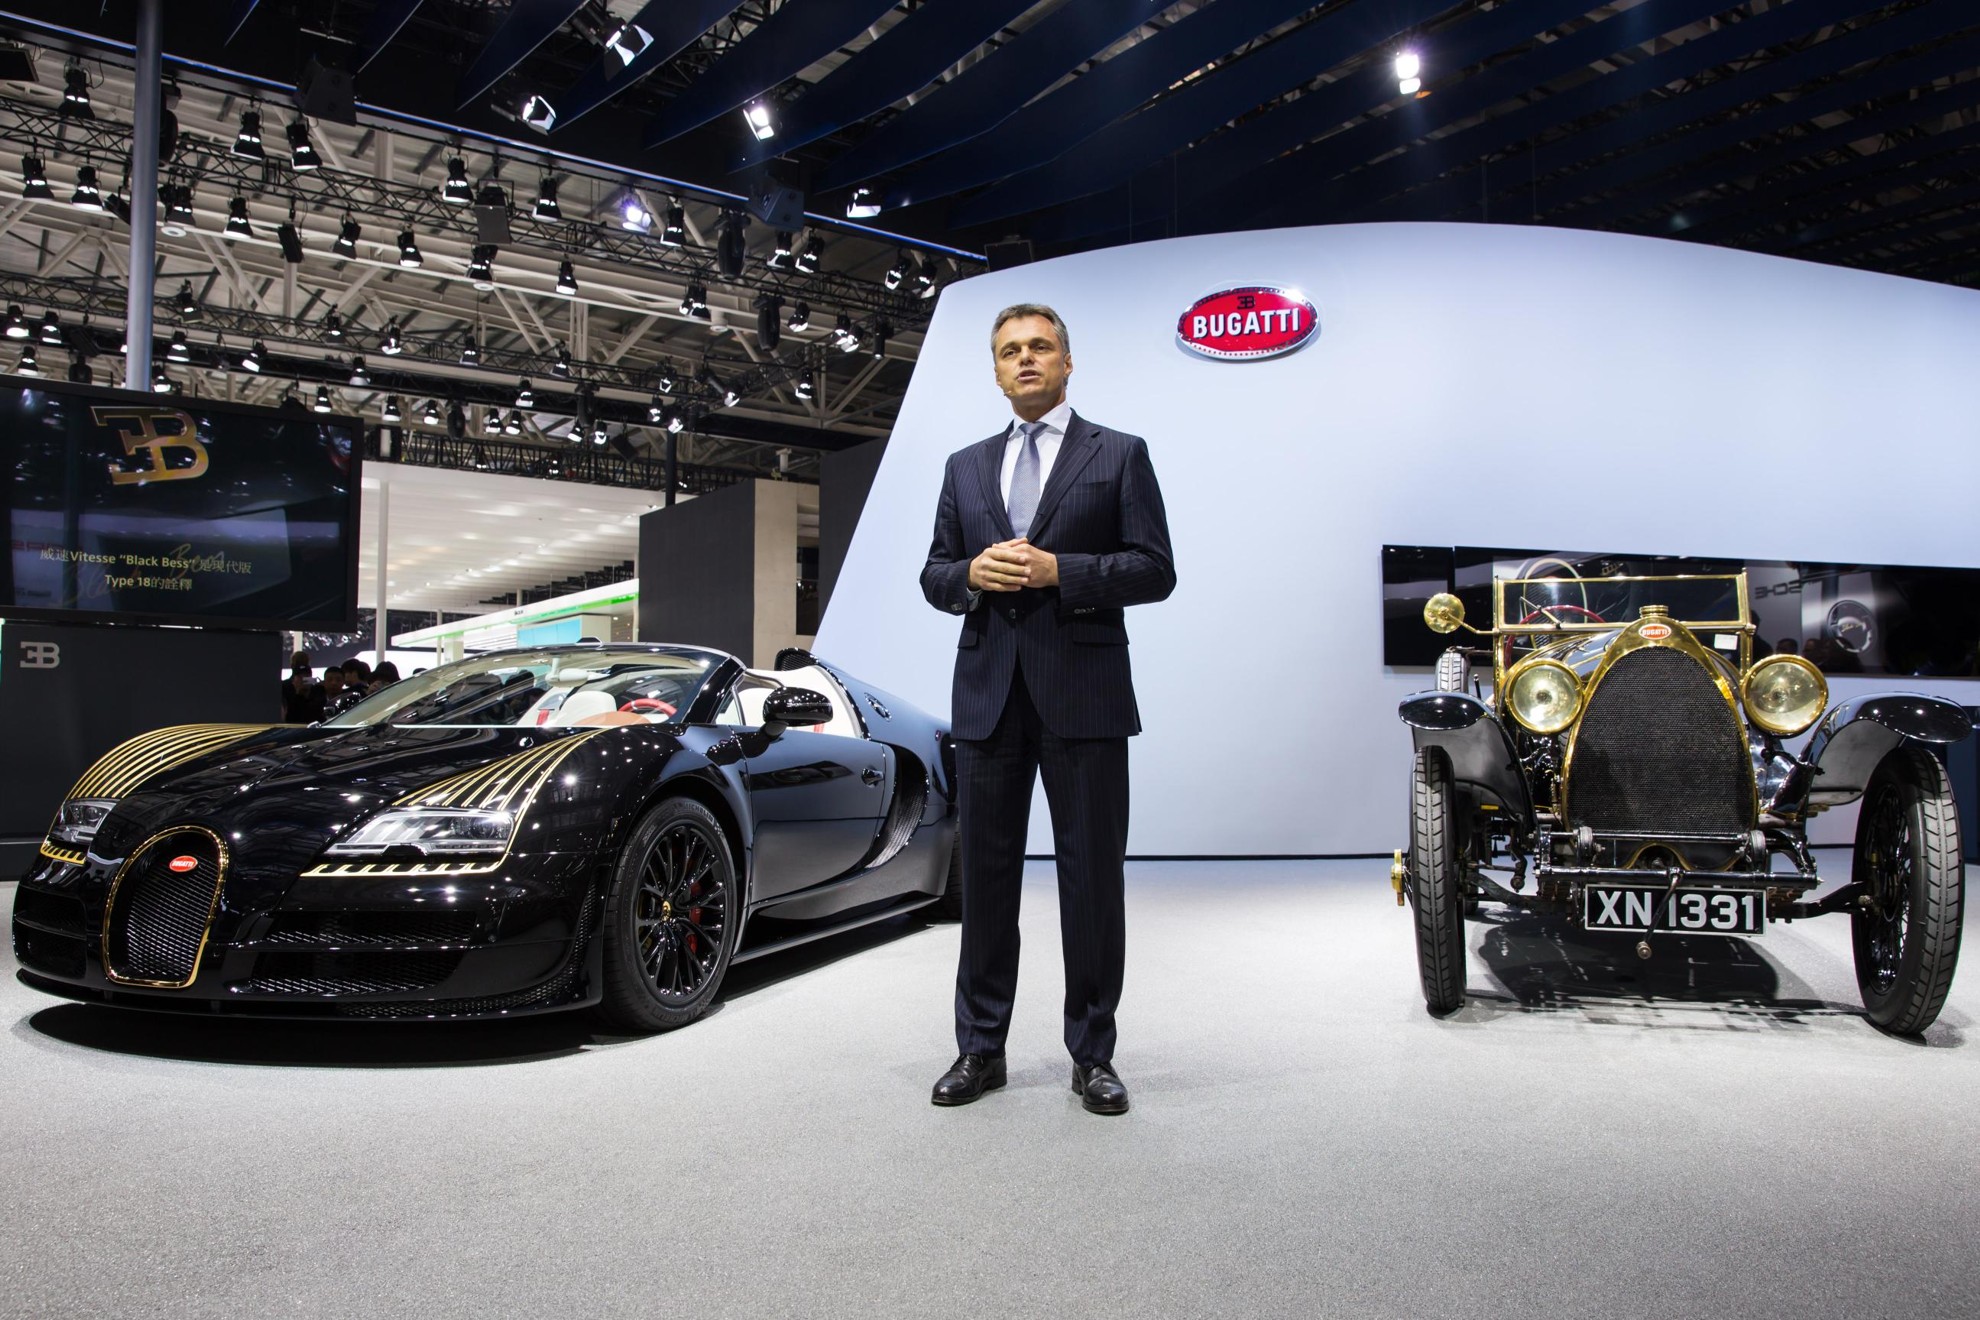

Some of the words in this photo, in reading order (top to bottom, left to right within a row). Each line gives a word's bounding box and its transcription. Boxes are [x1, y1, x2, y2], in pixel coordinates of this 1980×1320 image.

[1193, 307, 1299, 339] BUGATTI
[105, 574, 134, 587] Type
[1597, 890, 1652, 926] XN
[1668, 893, 1754, 931] 1331
